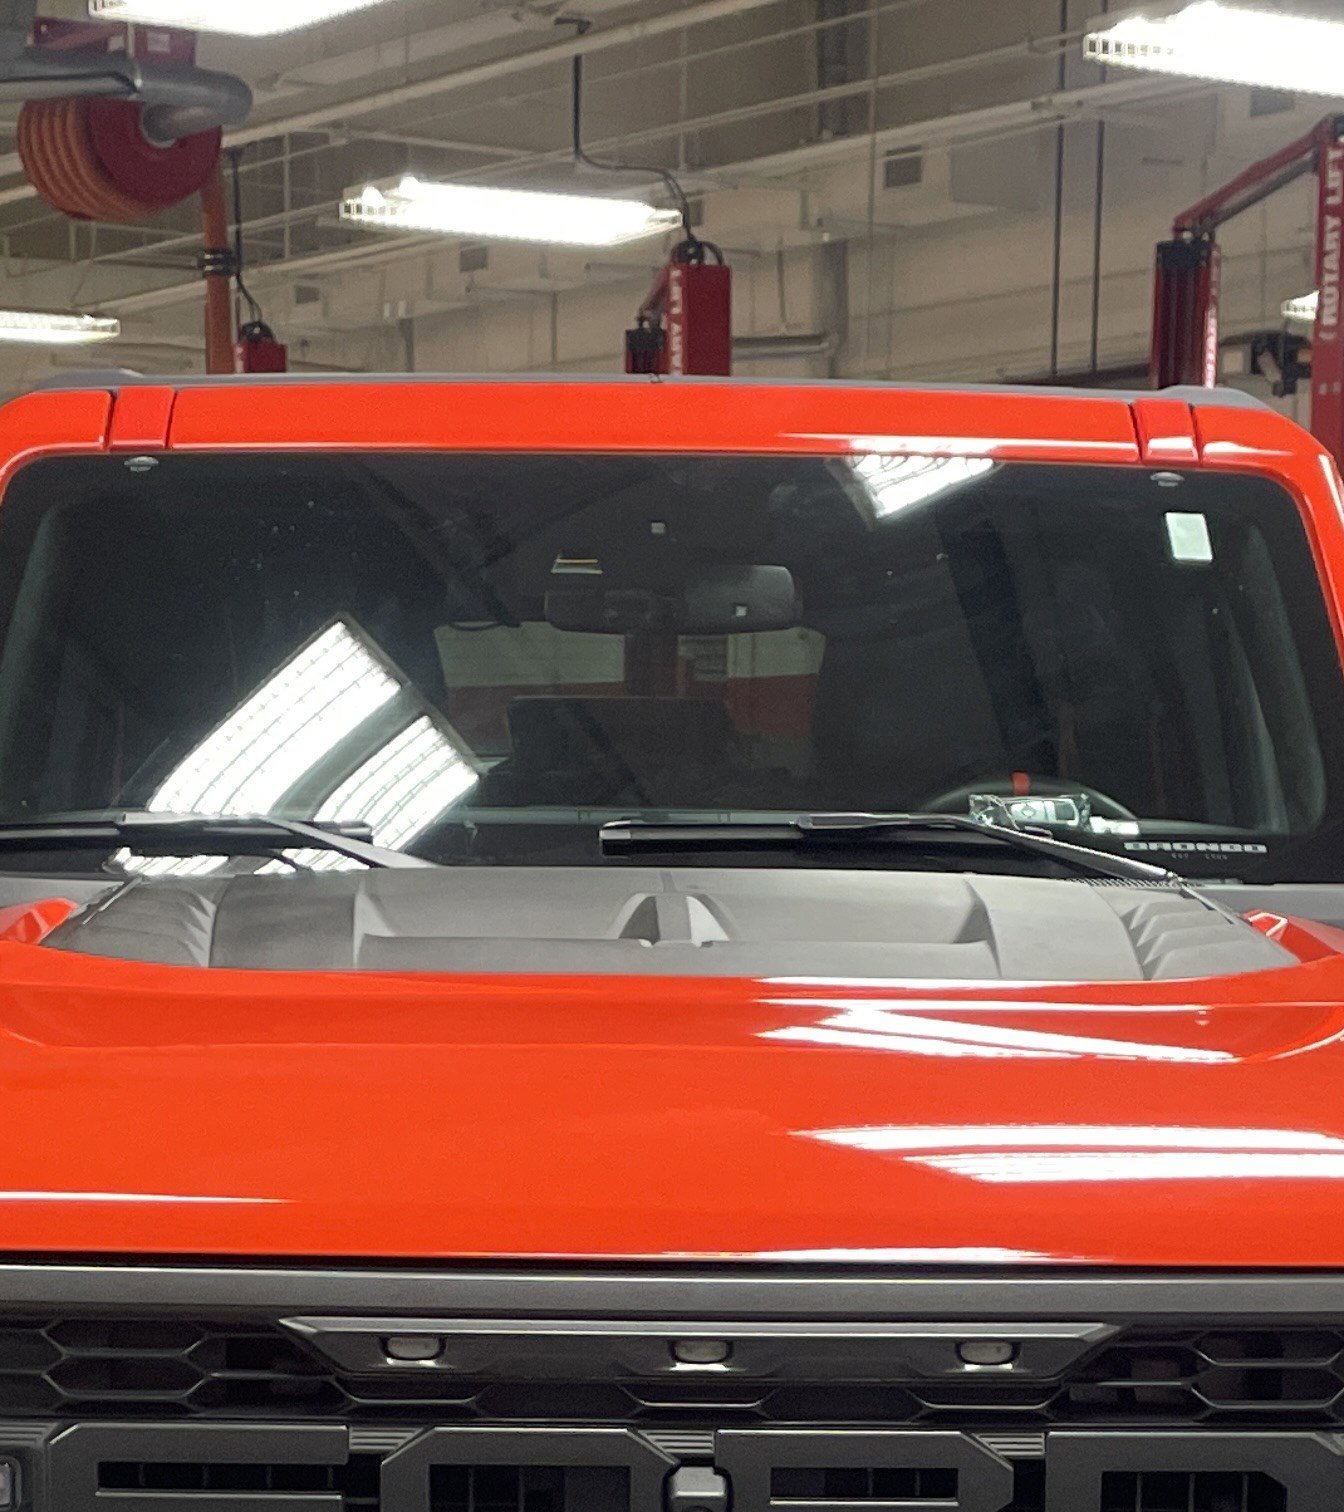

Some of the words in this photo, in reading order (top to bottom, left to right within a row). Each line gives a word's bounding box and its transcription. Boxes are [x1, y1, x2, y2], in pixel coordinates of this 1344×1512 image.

[1325, 147, 1344, 206] LIFT
[1321, 214, 1342, 326] ROTARY
[1123, 841, 1268, 854] BRONCO
